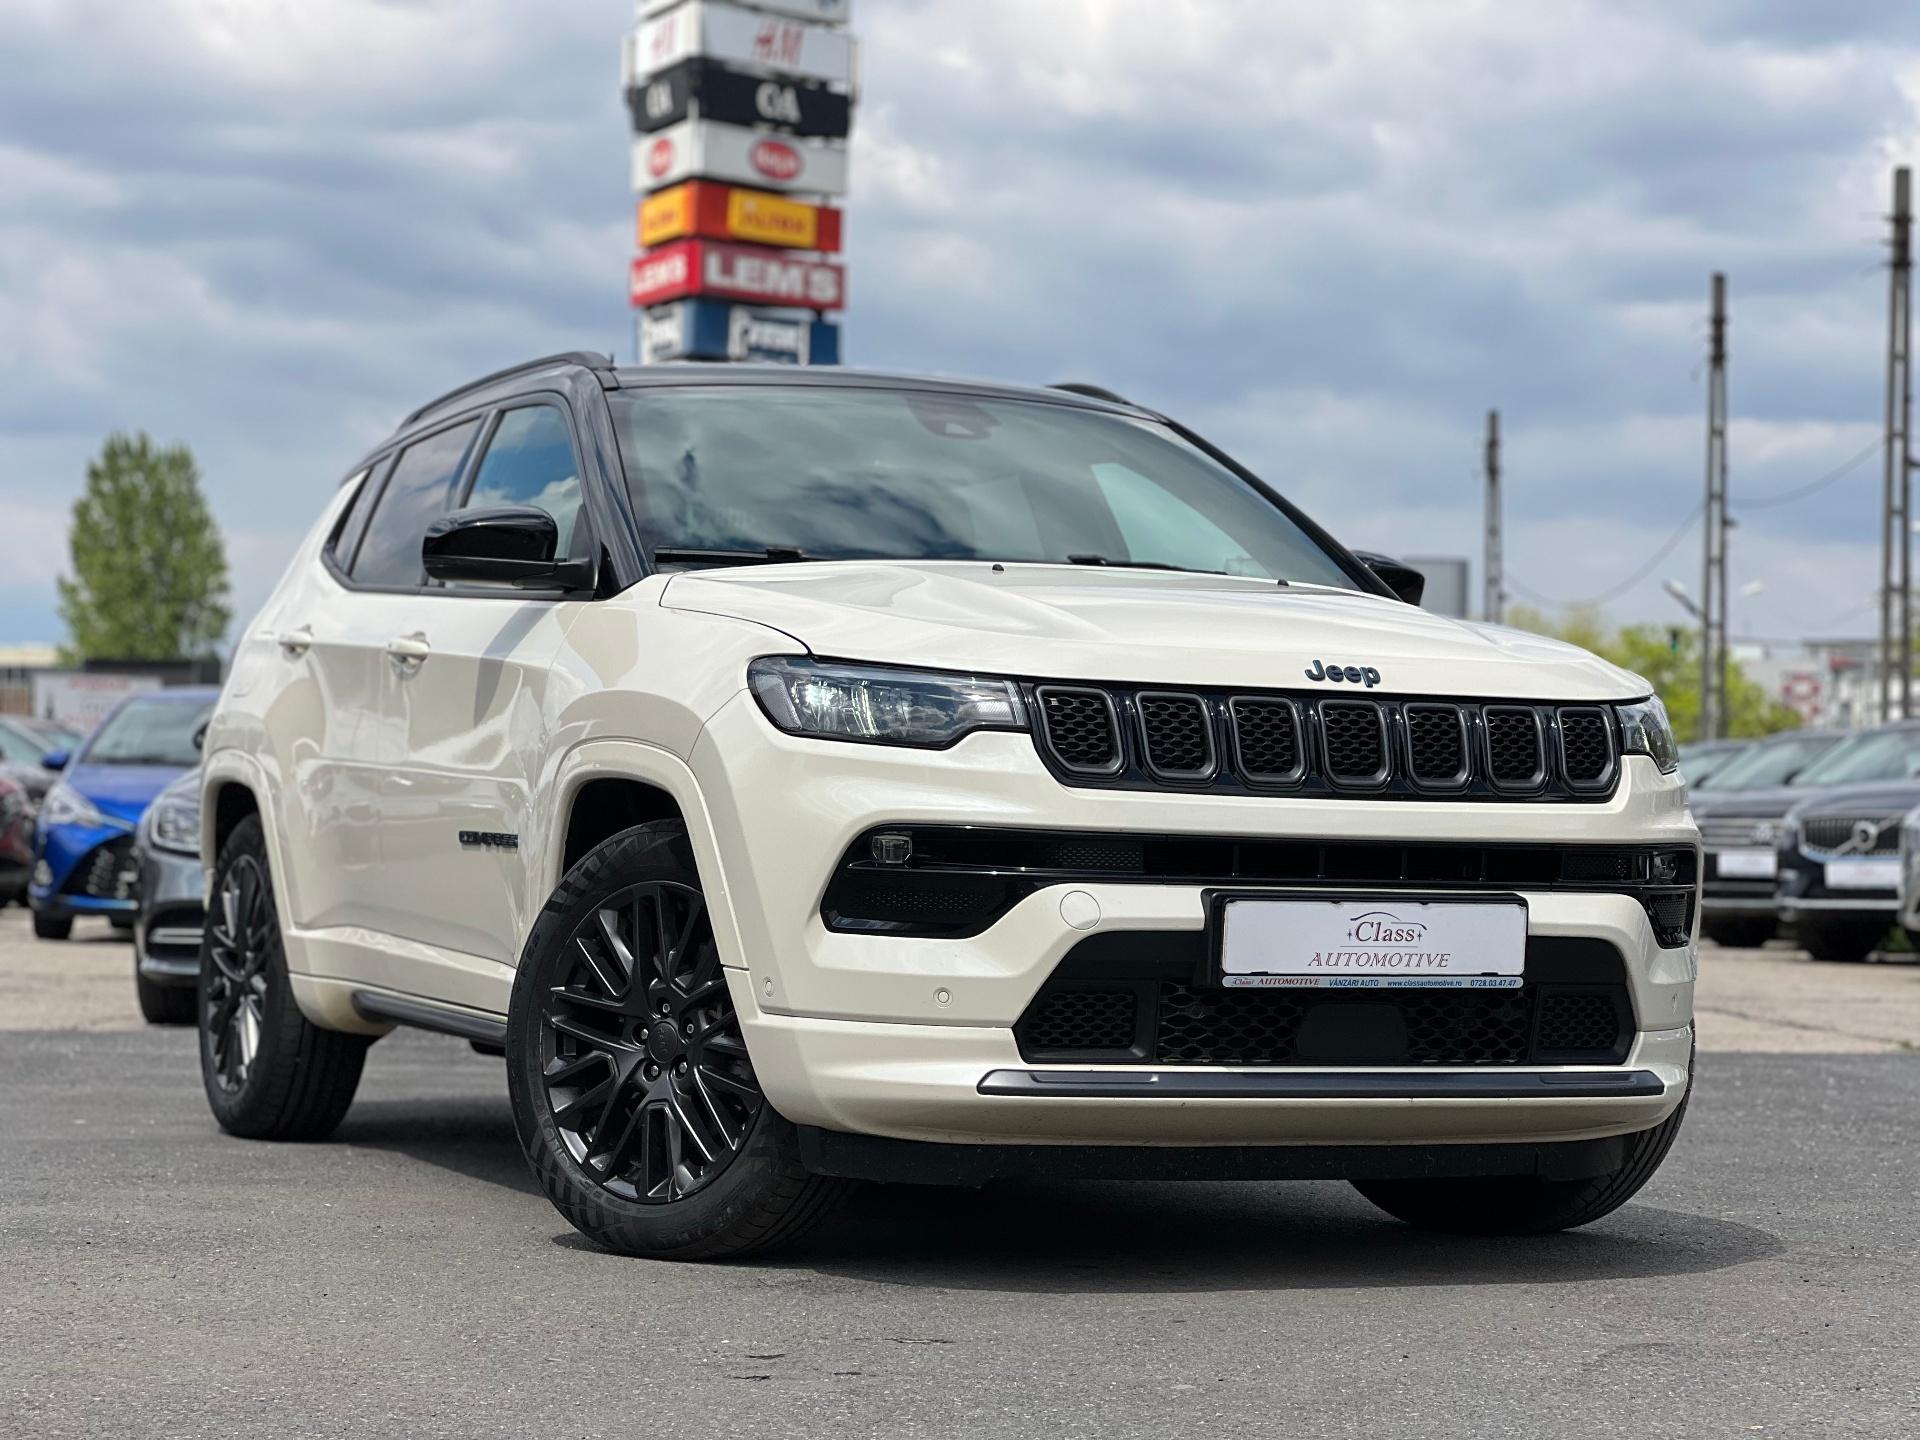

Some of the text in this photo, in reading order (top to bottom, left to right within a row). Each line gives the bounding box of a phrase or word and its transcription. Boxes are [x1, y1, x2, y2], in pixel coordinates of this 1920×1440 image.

[1304, 659, 1381, 688] Jeep
[1355, 921, 1415, 942] Class
[1307, 952, 1451, 968] AUTOMOTIVE
[1258, 978, 1320, 986] AUTOMOTIVE
[1360, 979, 1379, 987] AUTO
